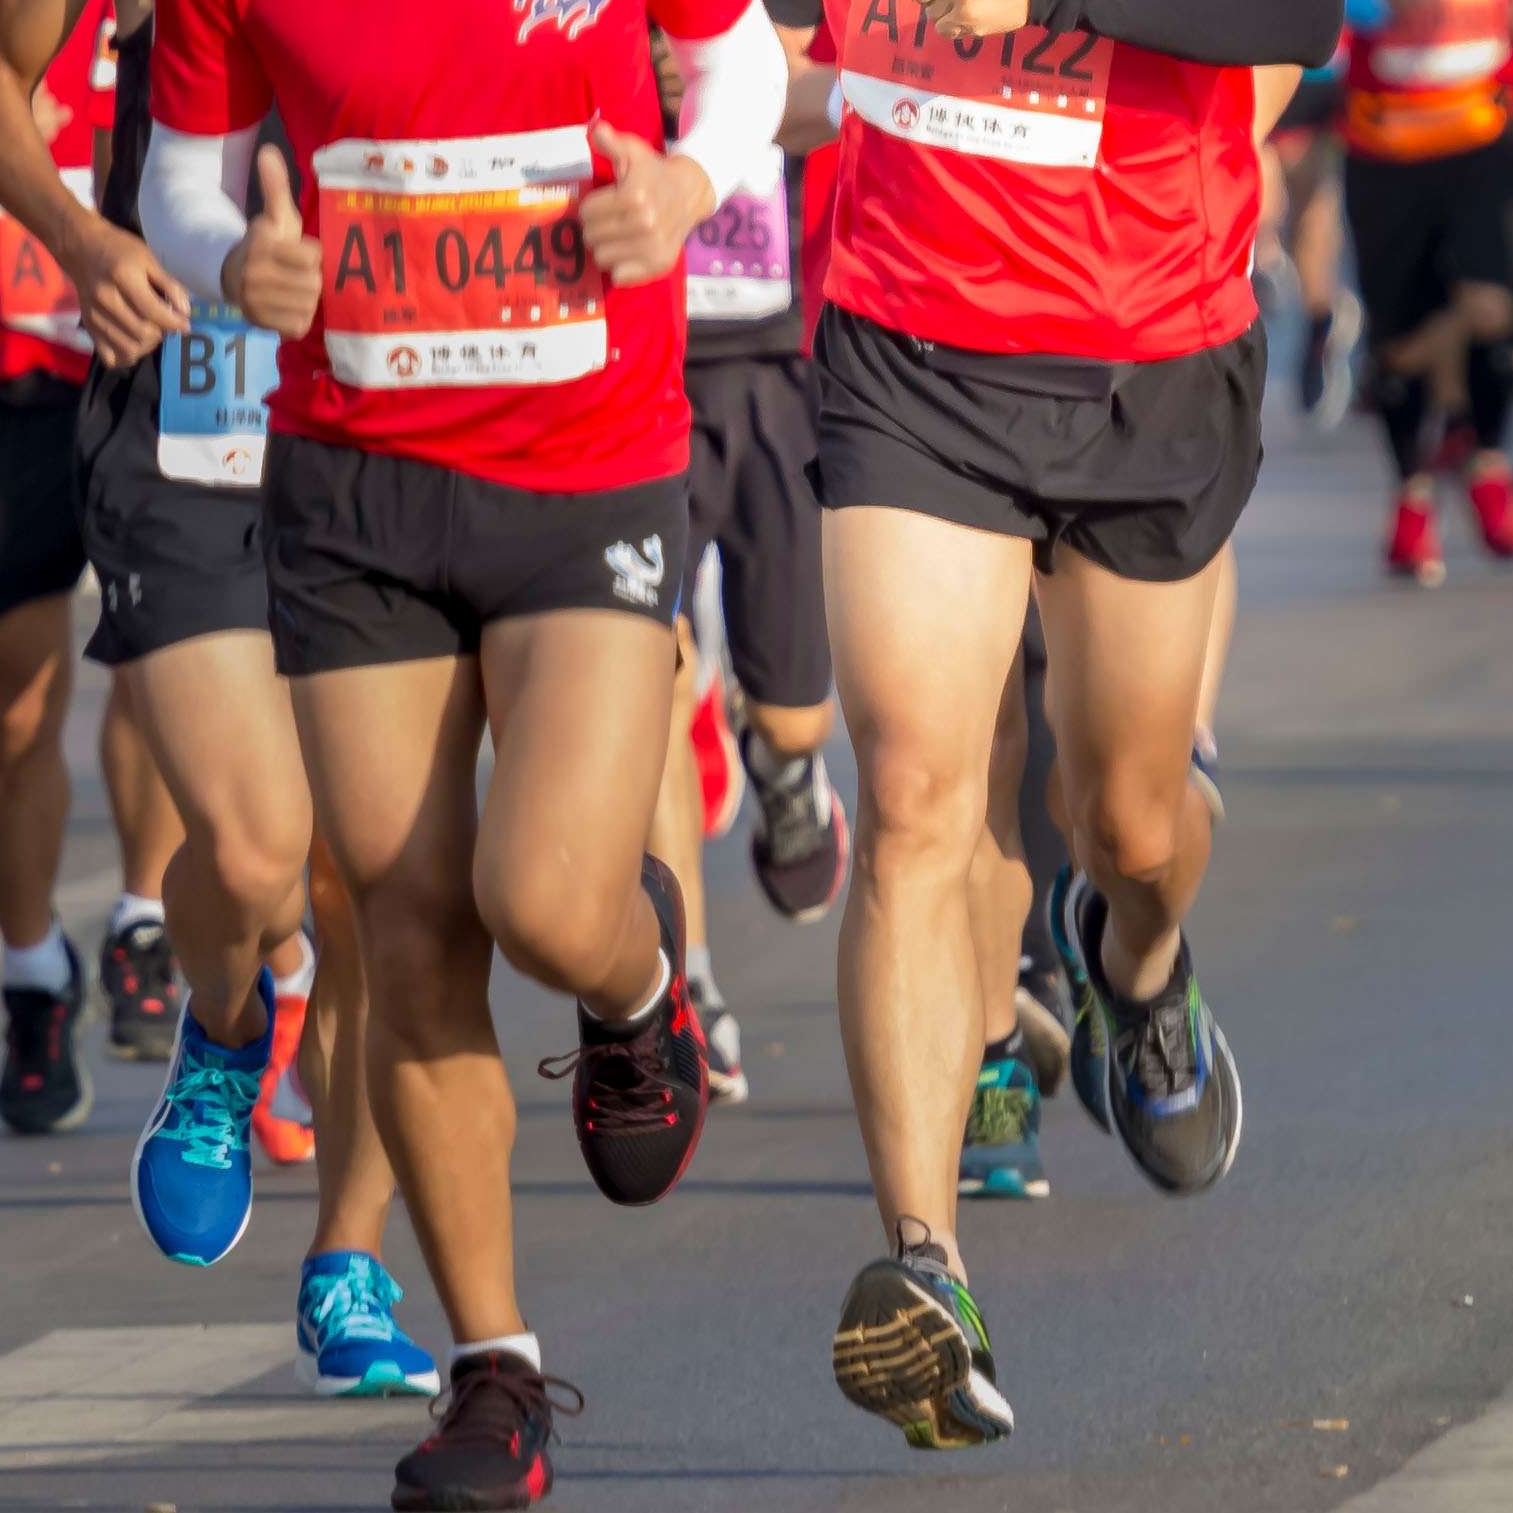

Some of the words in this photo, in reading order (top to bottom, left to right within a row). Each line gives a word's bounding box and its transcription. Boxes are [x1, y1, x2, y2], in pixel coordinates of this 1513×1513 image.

[335, 224, 406, 294] A1
[435, 218, 586, 294] 0449
[180, 332, 246, 400] B1
